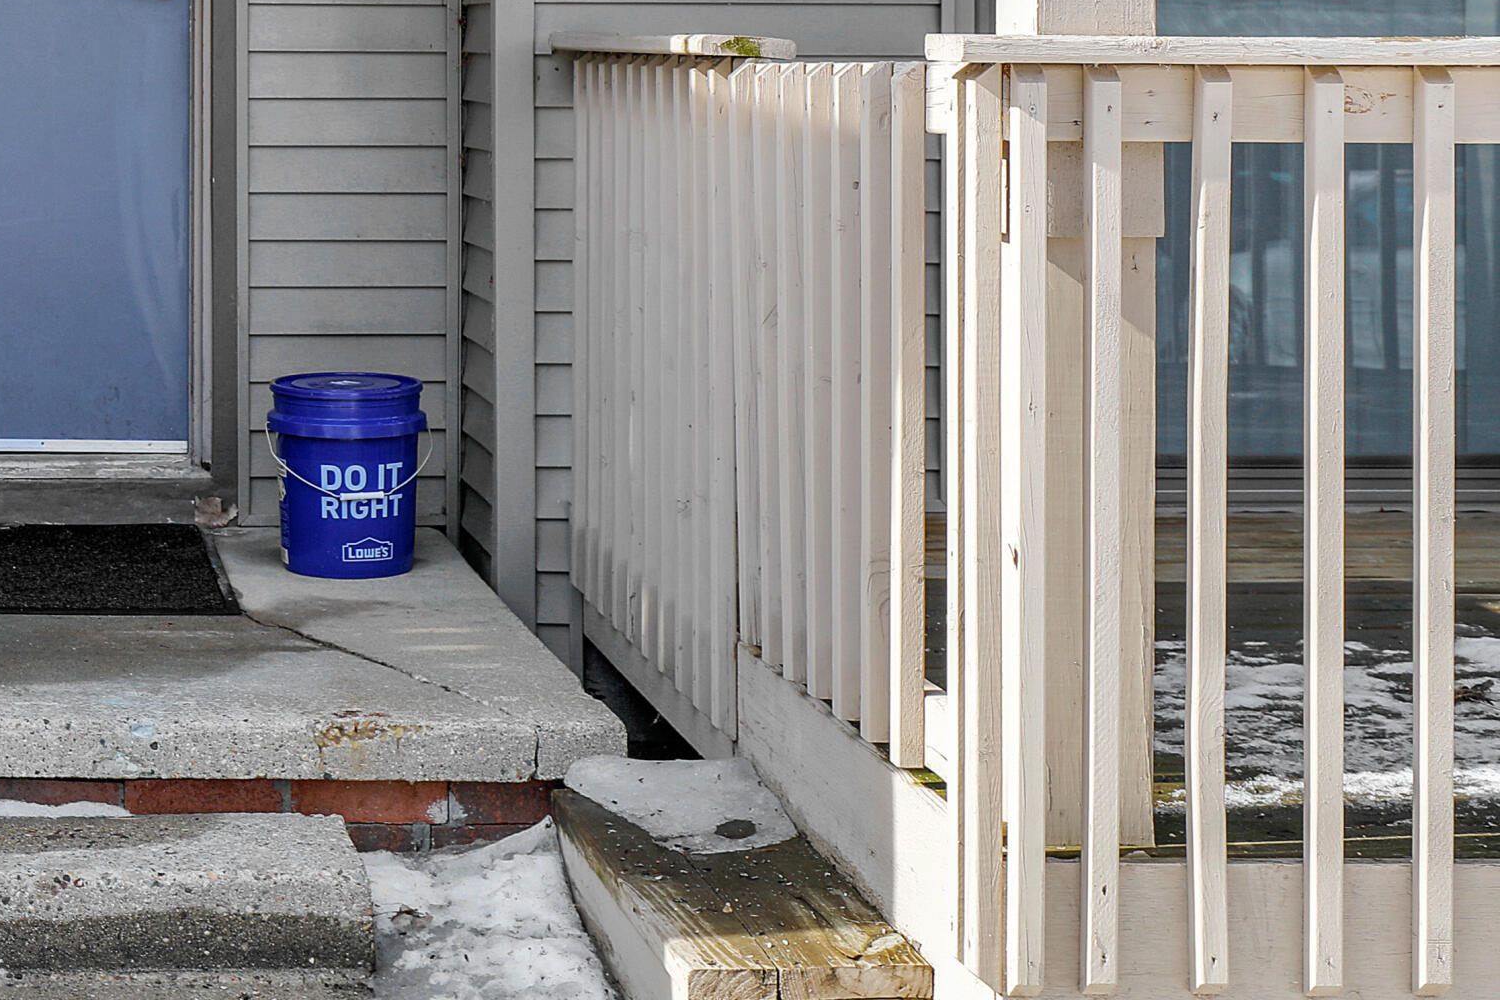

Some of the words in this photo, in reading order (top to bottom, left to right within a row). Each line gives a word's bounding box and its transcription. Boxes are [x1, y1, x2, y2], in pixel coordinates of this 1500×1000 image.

[320, 464, 367, 491] DO
[378, 462, 403, 490] IT
[320, 494, 403, 520] RIGHT
[348, 546, 390, 559] LOWE'S
